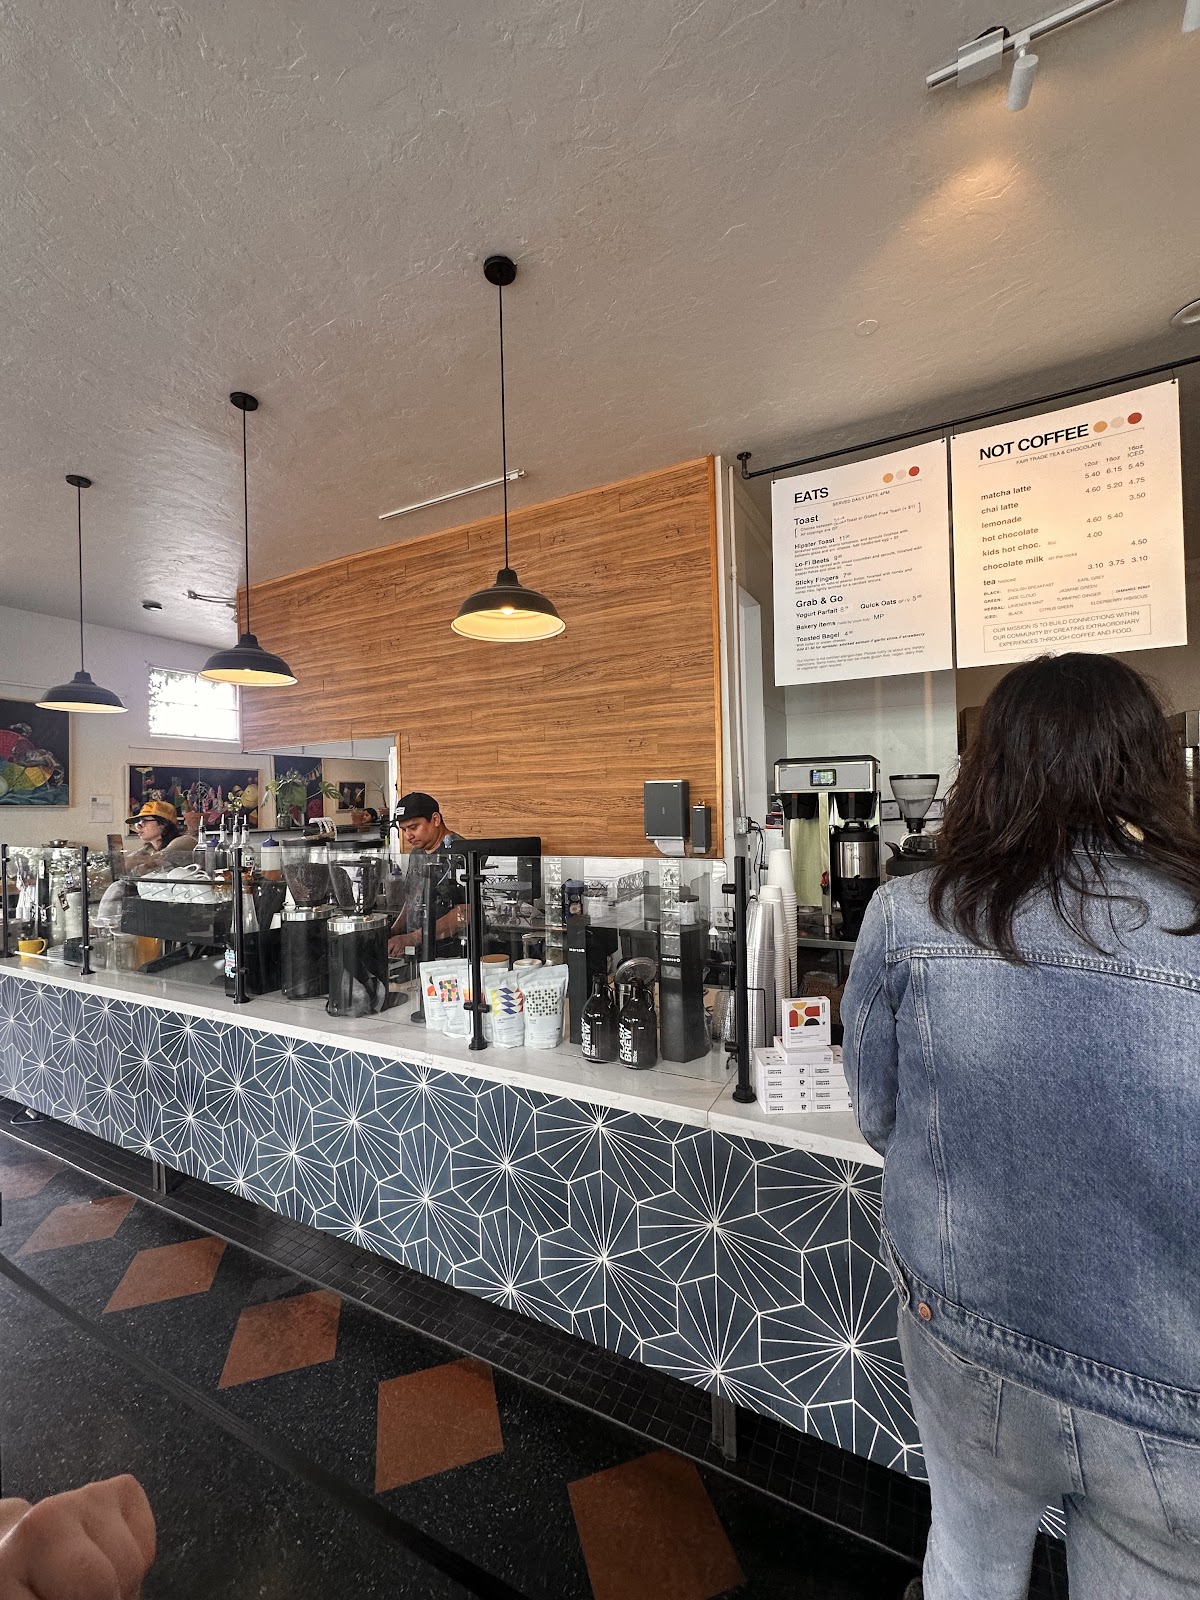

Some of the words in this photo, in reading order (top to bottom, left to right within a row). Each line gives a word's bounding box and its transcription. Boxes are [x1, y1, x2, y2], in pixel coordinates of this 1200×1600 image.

[980, 441, 1014, 461] NOT
[1018, 424, 1089, 452] COFFEE
[1030, 454, 1048, 462] TRADE
[1067, 442, 1101, 453] CHOCOLATE
[1106, 466, 1122, 474] 6.15
[1129, 477, 1145, 485] 4.75
[795, 486, 828, 504] EATS
[981, 489, 1011, 500] matcha
[1013, 485, 1031, 494] latte
[981, 506, 998, 514] chai
[1001, 502, 1018, 510] latte
[794, 514, 818, 526] Toast
[982, 516, 1022, 528] lemonade
[998, 528, 1038, 540] chocolate
[795, 541, 816, 550] Hipster
[819, 537, 834, 545] Toast
[982, 549, 999, 557] kids
[1018, 542, 1040, 550] choc.
[983, 559, 1023, 571] chocolate
[1026, 556, 1044, 564] milk
[816, 574, 838, 583] Fingers
[796, 598, 817, 608] Grab
[830, 594, 843, 603] Go
[861, 601, 879, 609] Quick
[796, 611, 815, 619] Yogurt
[818, 608, 838, 616] Parfait
[1069, 614, 1115, 624] CONNECTIONS
[796, 623, 818, 631] Bakery
[1007, 631, 1042, 639] COMMUNITY
[1054, 625, 1084, 633] CREATING
[1086, 619, 1139, 629] EXTRAORDINARY
[797, 635, 820, 643] Toasted
[822, 632, 839, 640] Bagel
[999, 639, 1038, 647] EXPERIENCES
[624, 1027, 632, 1062] BREW
